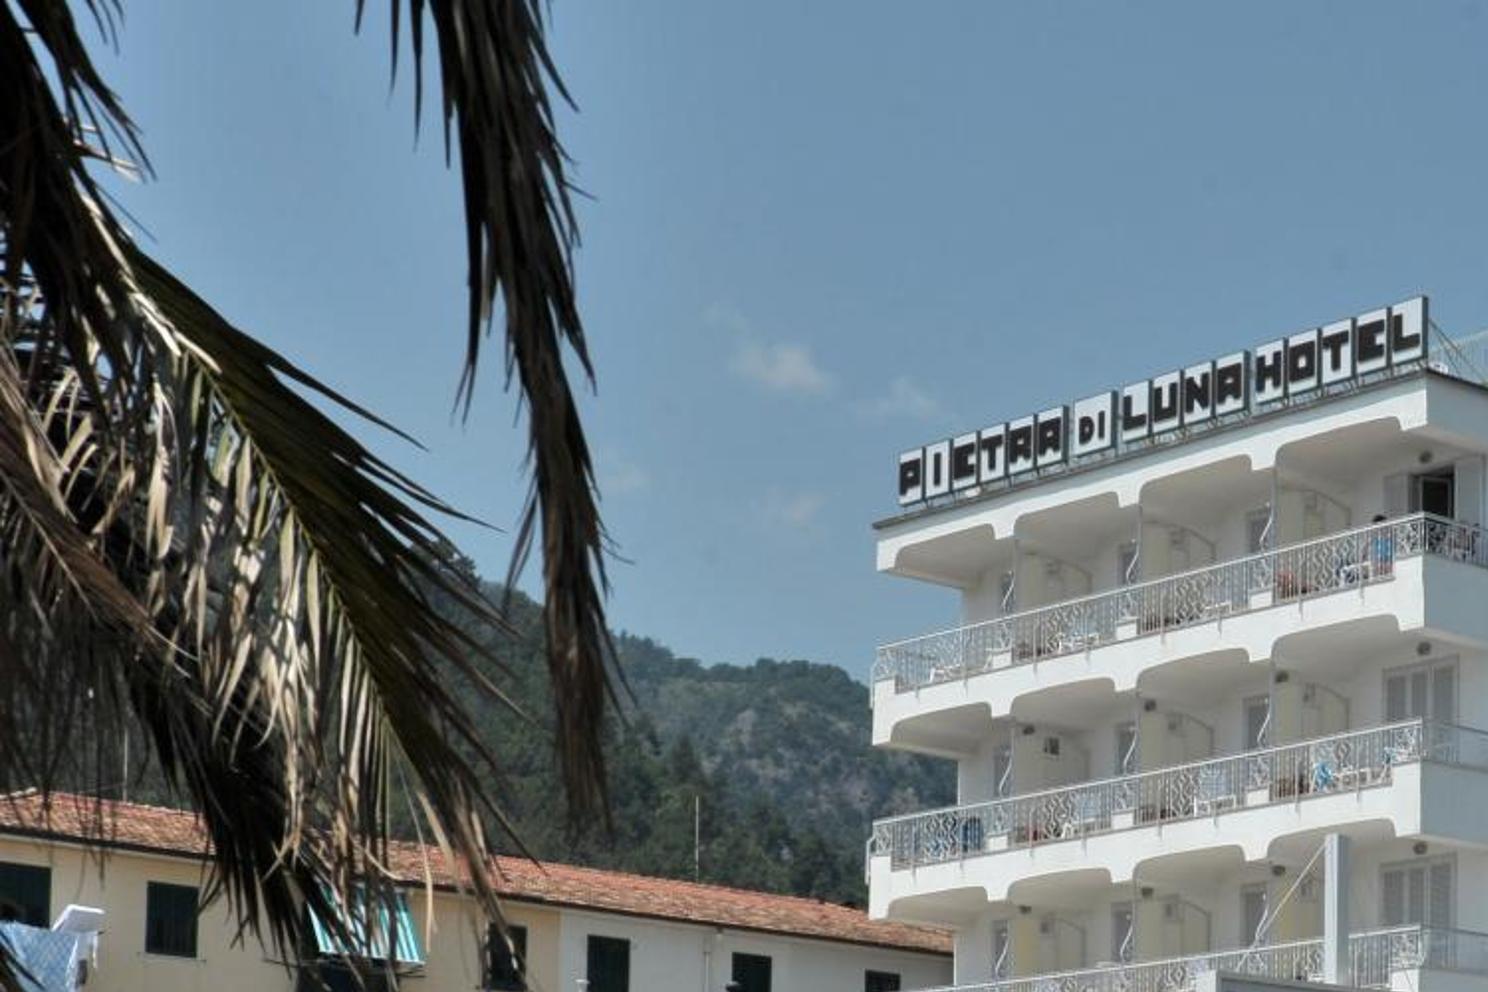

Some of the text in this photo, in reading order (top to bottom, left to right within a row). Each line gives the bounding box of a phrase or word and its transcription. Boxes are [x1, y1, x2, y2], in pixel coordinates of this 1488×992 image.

[899, 313, 1421, 496] PIETRA DI LUNA HOTEL
